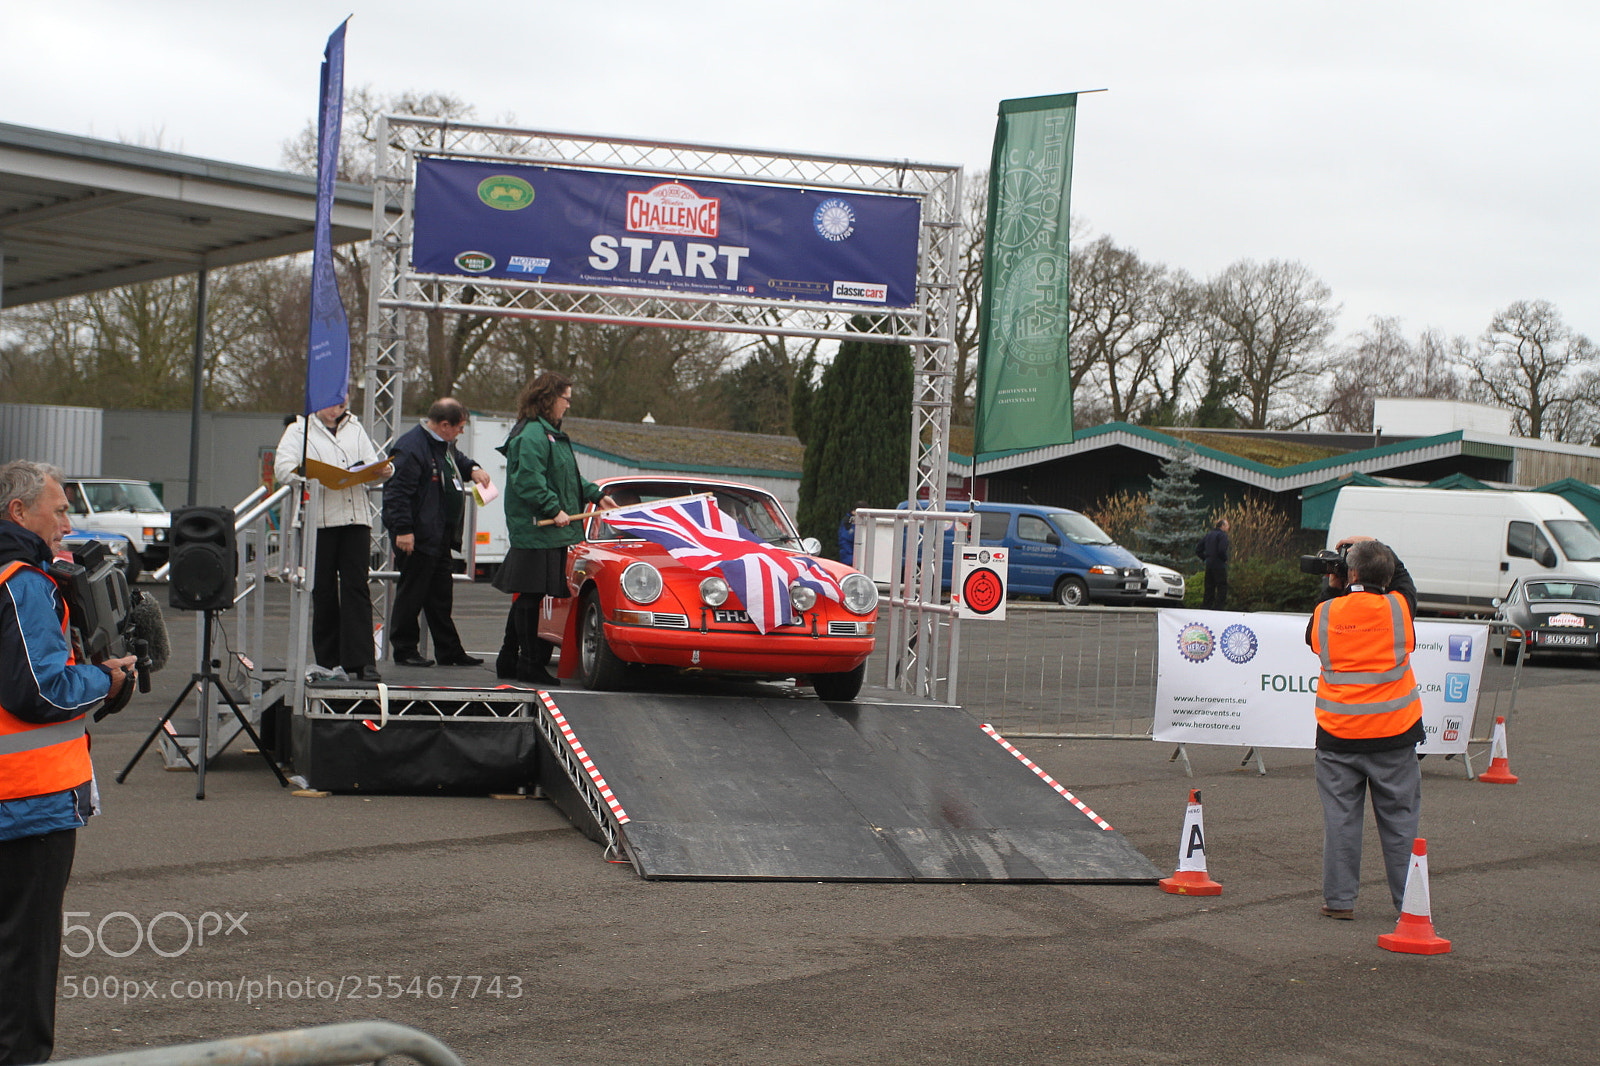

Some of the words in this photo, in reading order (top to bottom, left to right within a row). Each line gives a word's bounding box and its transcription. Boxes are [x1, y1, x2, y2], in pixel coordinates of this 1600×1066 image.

[630, 195, 716, 235] CHALLENGE
[816, 200, 837, 221] CLASSIC
[840, 201, 856, 222] RALLY
[817, 224, 854, 241] ASSOCIATION
[511, 257, 549, 267] MOTORS
[588, 234, 750, 281] START
[1222, 626, 1240, 644] CLASSIC
[1242, 627, 1256, 645] RALLY
[1223, 647, 1255, 663] ASSOCIATION
[1173, 696, 1247, 704] www.heroevents.eu
[1172, 708, 1241, 717] www.craevents.eu
[1171, 721, 1241, 730] www.herostore.eu
[1446, 719, 1460, 730] You
[1444, 730, 1458, 740] Tube
[1187, 824, 1206, 859] A
